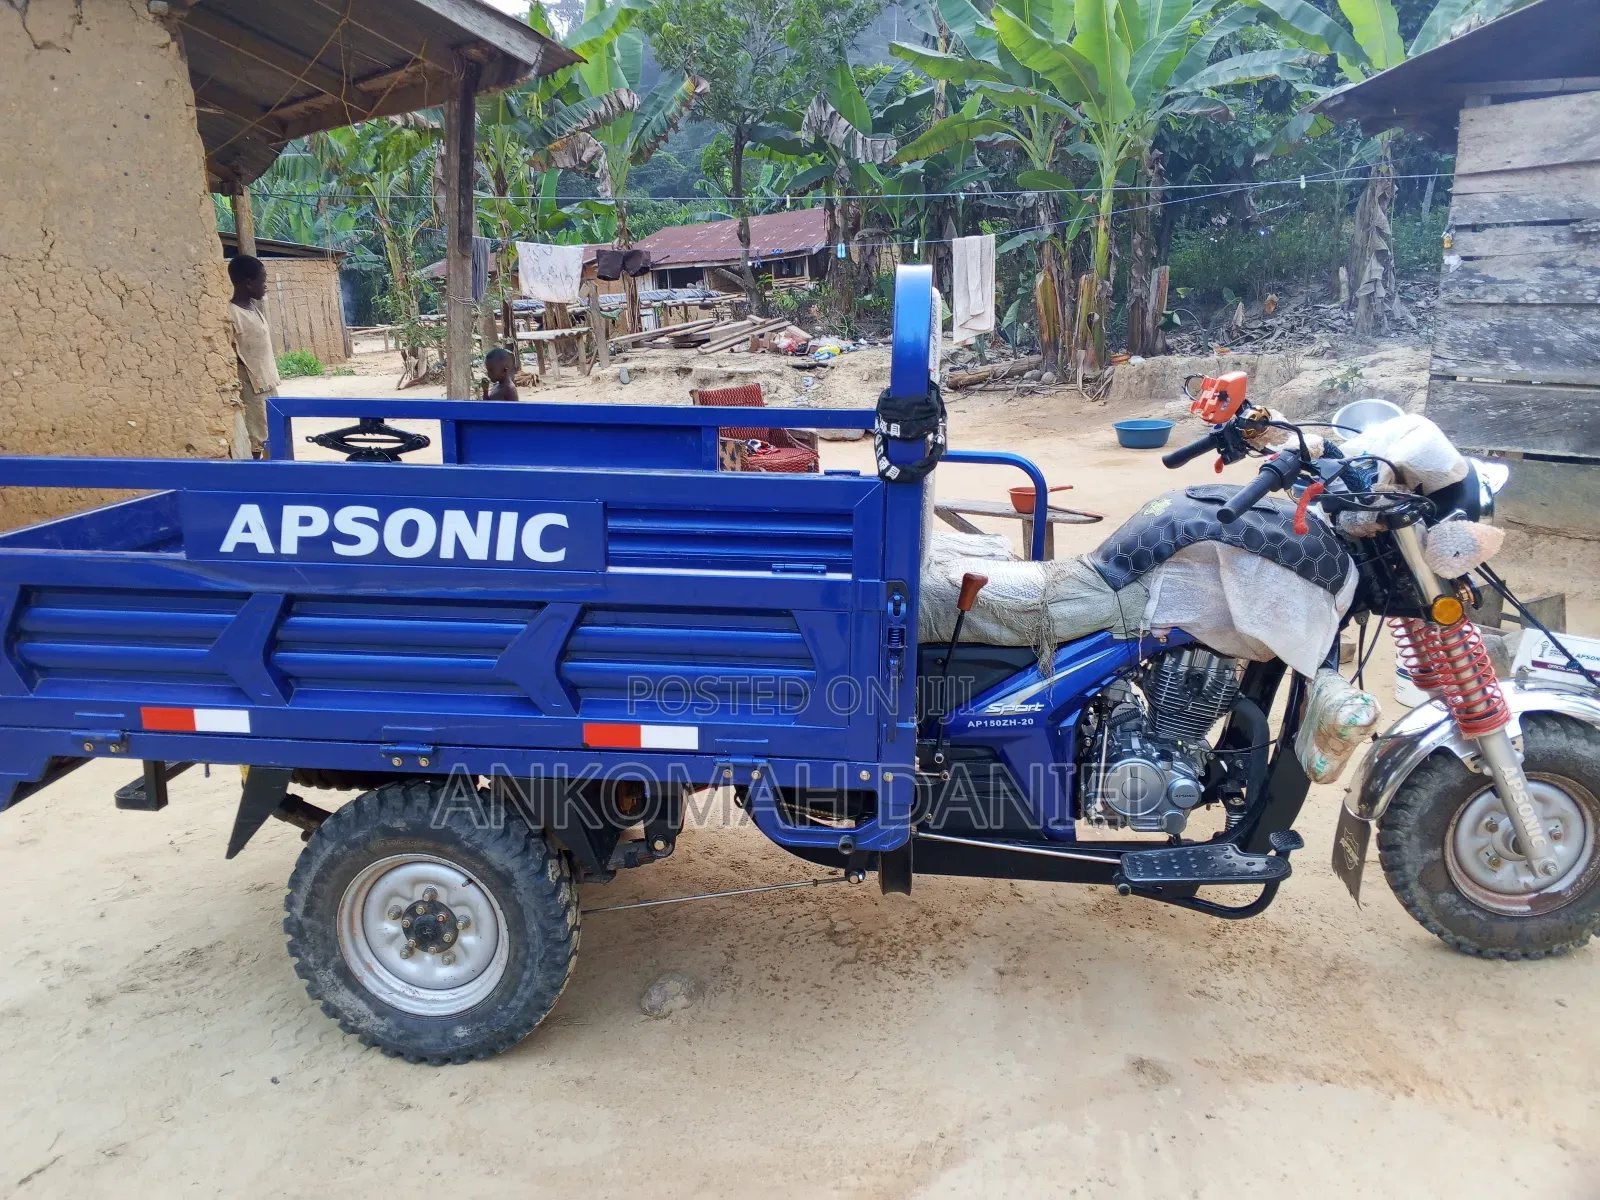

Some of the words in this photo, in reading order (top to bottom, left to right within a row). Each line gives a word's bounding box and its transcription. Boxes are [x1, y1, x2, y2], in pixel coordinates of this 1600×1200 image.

[218, 503, 570, 563] APSONIC
[967, 718, 1034, 728] AP150ZH-20
[984, 701, 1045, 715] Sport
[1499, 766, 1547, 847] APSONIC
